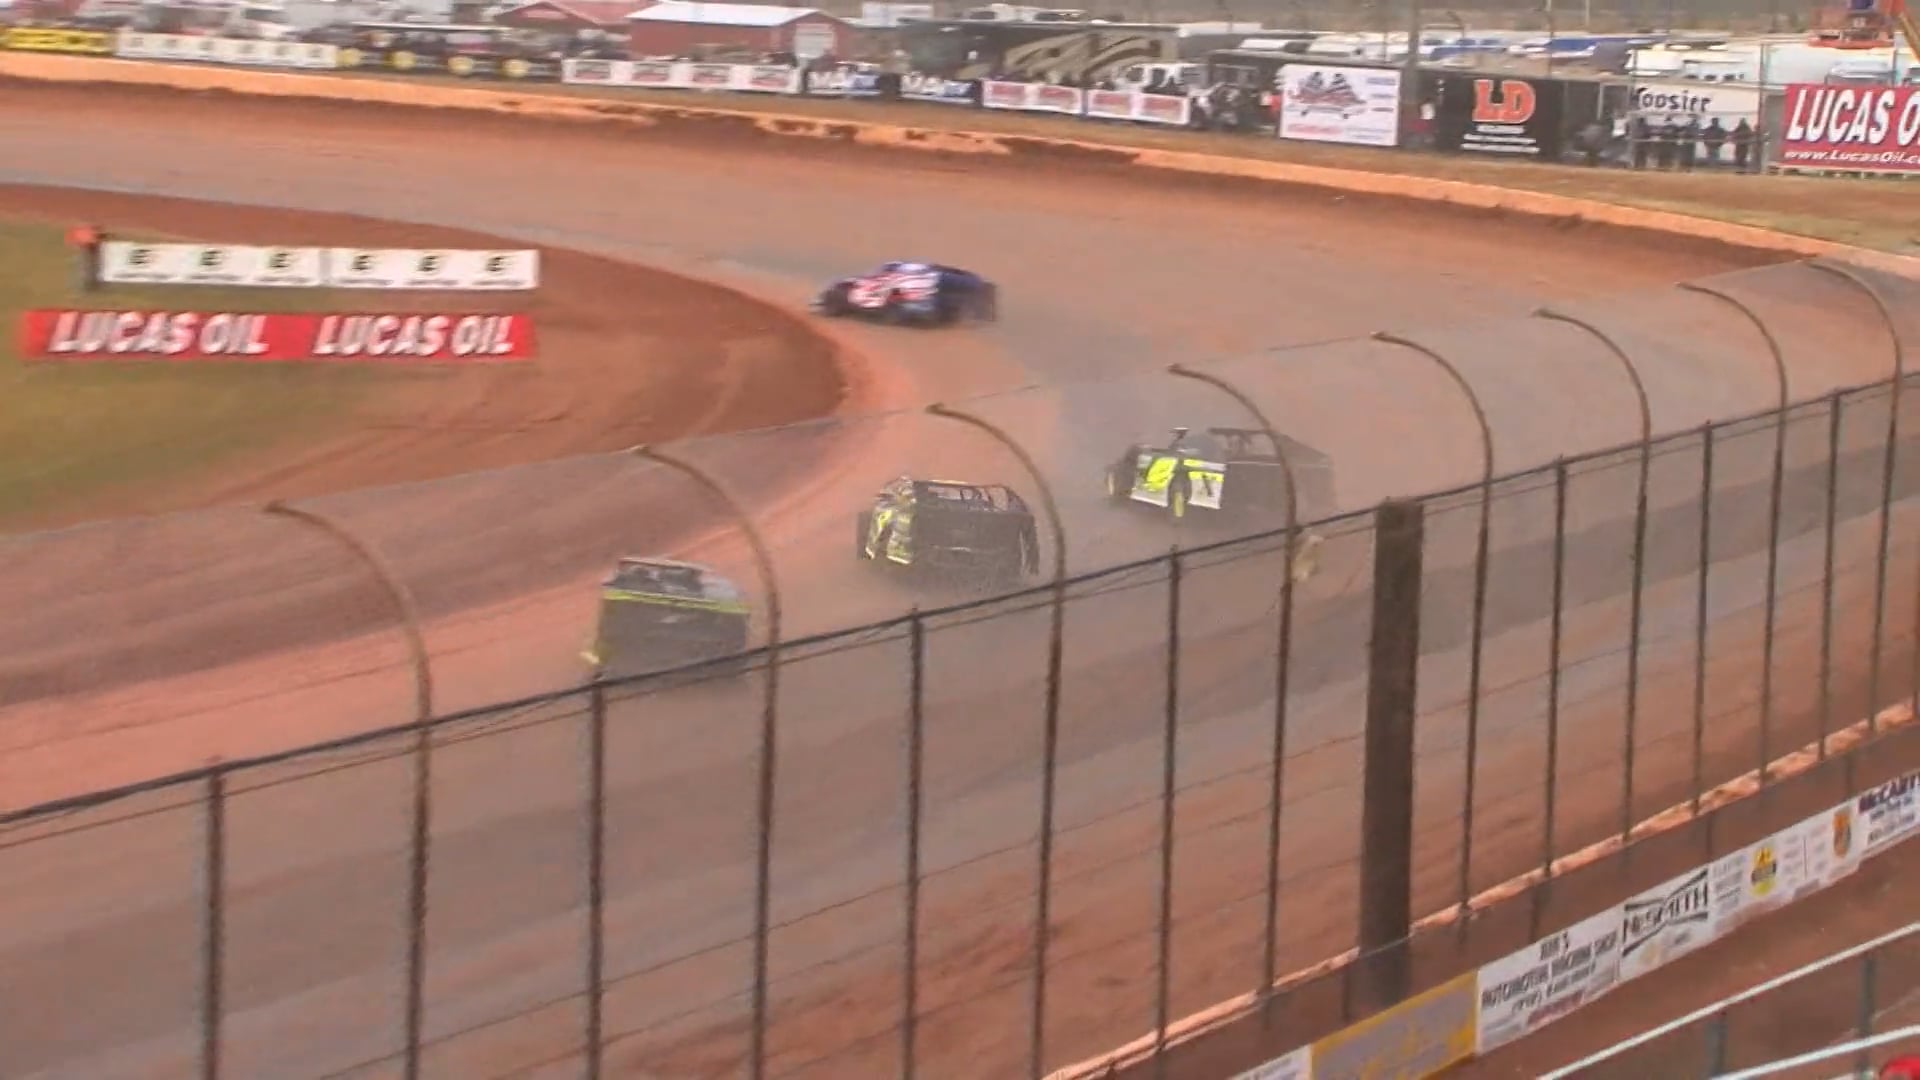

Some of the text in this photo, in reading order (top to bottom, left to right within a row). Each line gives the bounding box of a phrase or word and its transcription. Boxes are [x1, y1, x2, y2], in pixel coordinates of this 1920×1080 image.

[1472, 79, 1536, 123] LD
[1786, 89, 1920, 146] LUCAS O
[1784, 150, 1920, 164] www.LucasOil.c
[48, 311, 270, 354] LUCAS OIL
[313, 315, 514, 356] LUCAS OIL
